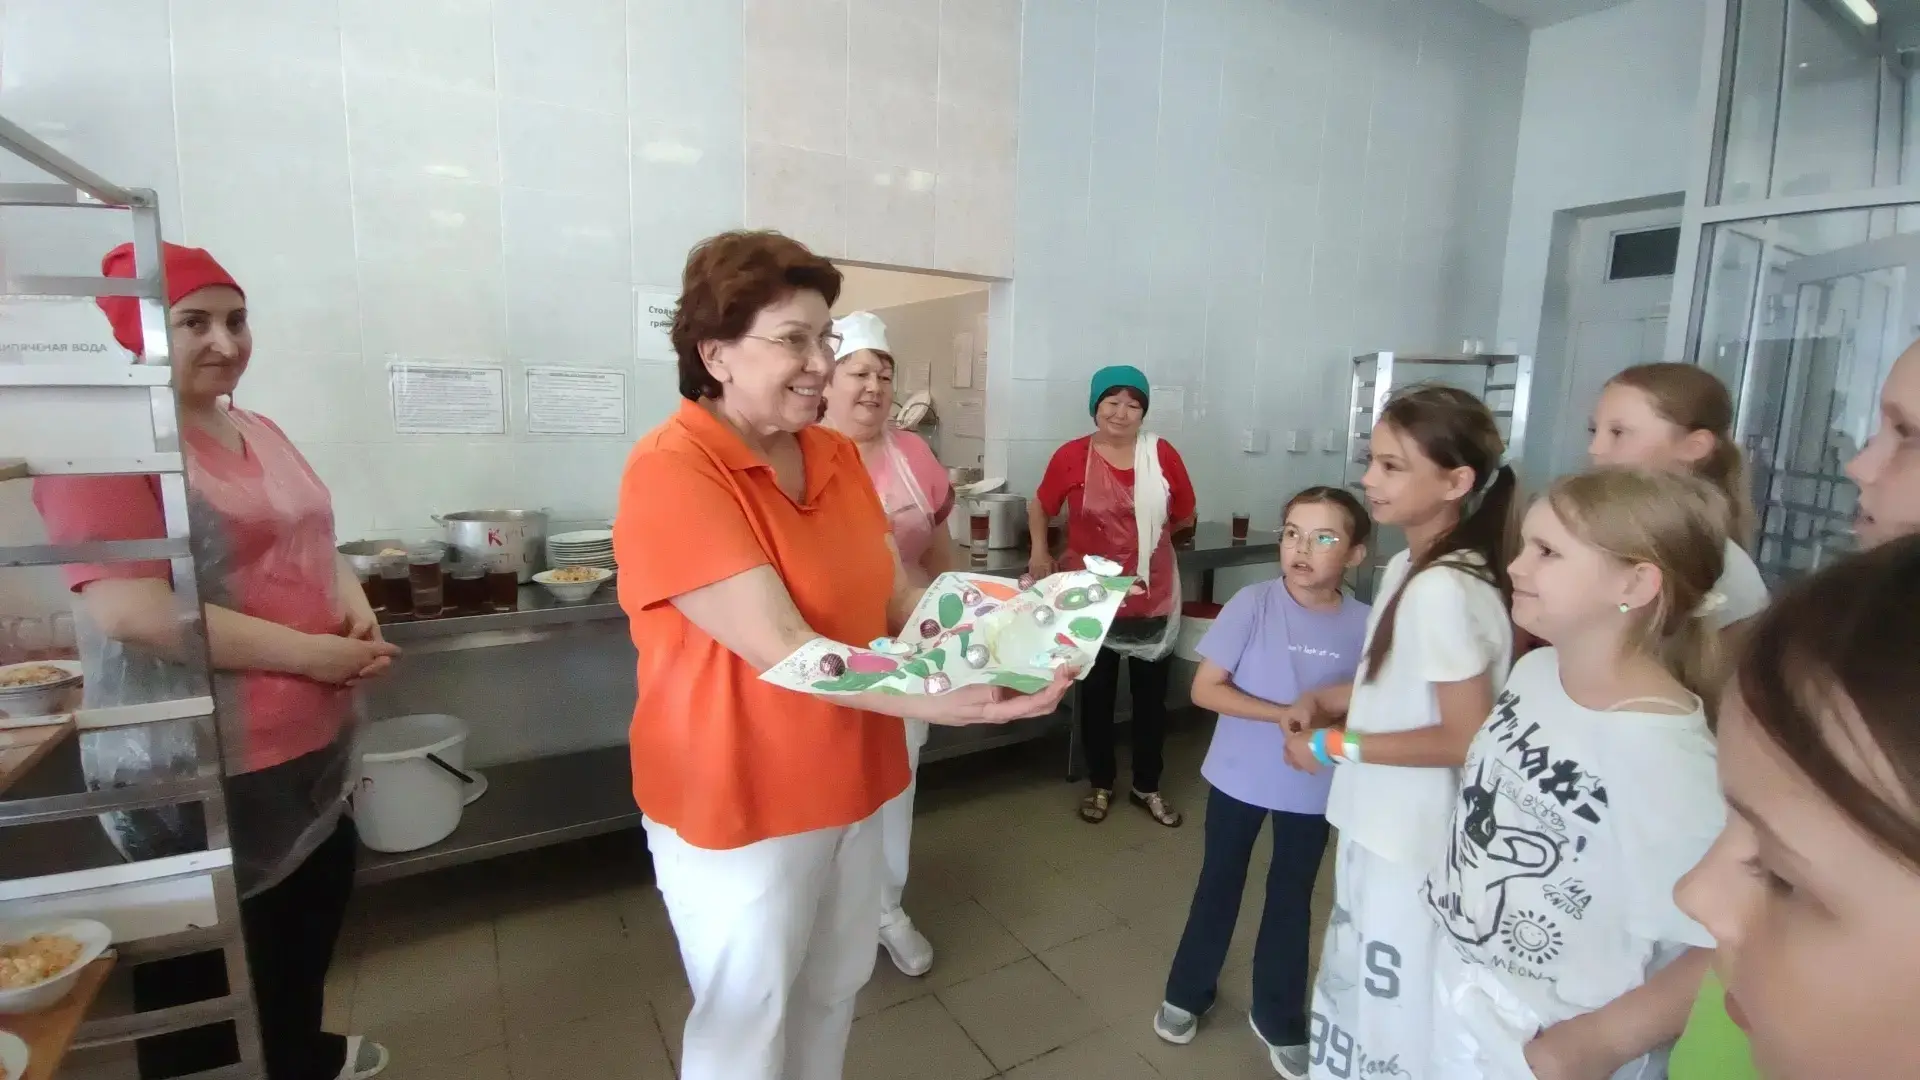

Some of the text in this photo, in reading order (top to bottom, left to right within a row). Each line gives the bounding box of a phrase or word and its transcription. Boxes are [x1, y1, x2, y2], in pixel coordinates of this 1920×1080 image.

[71, 343, 108, 353] ВОДА
[1542, 884, 1584, 920] GENIUS
[1364, 940, 1402, 999] S
